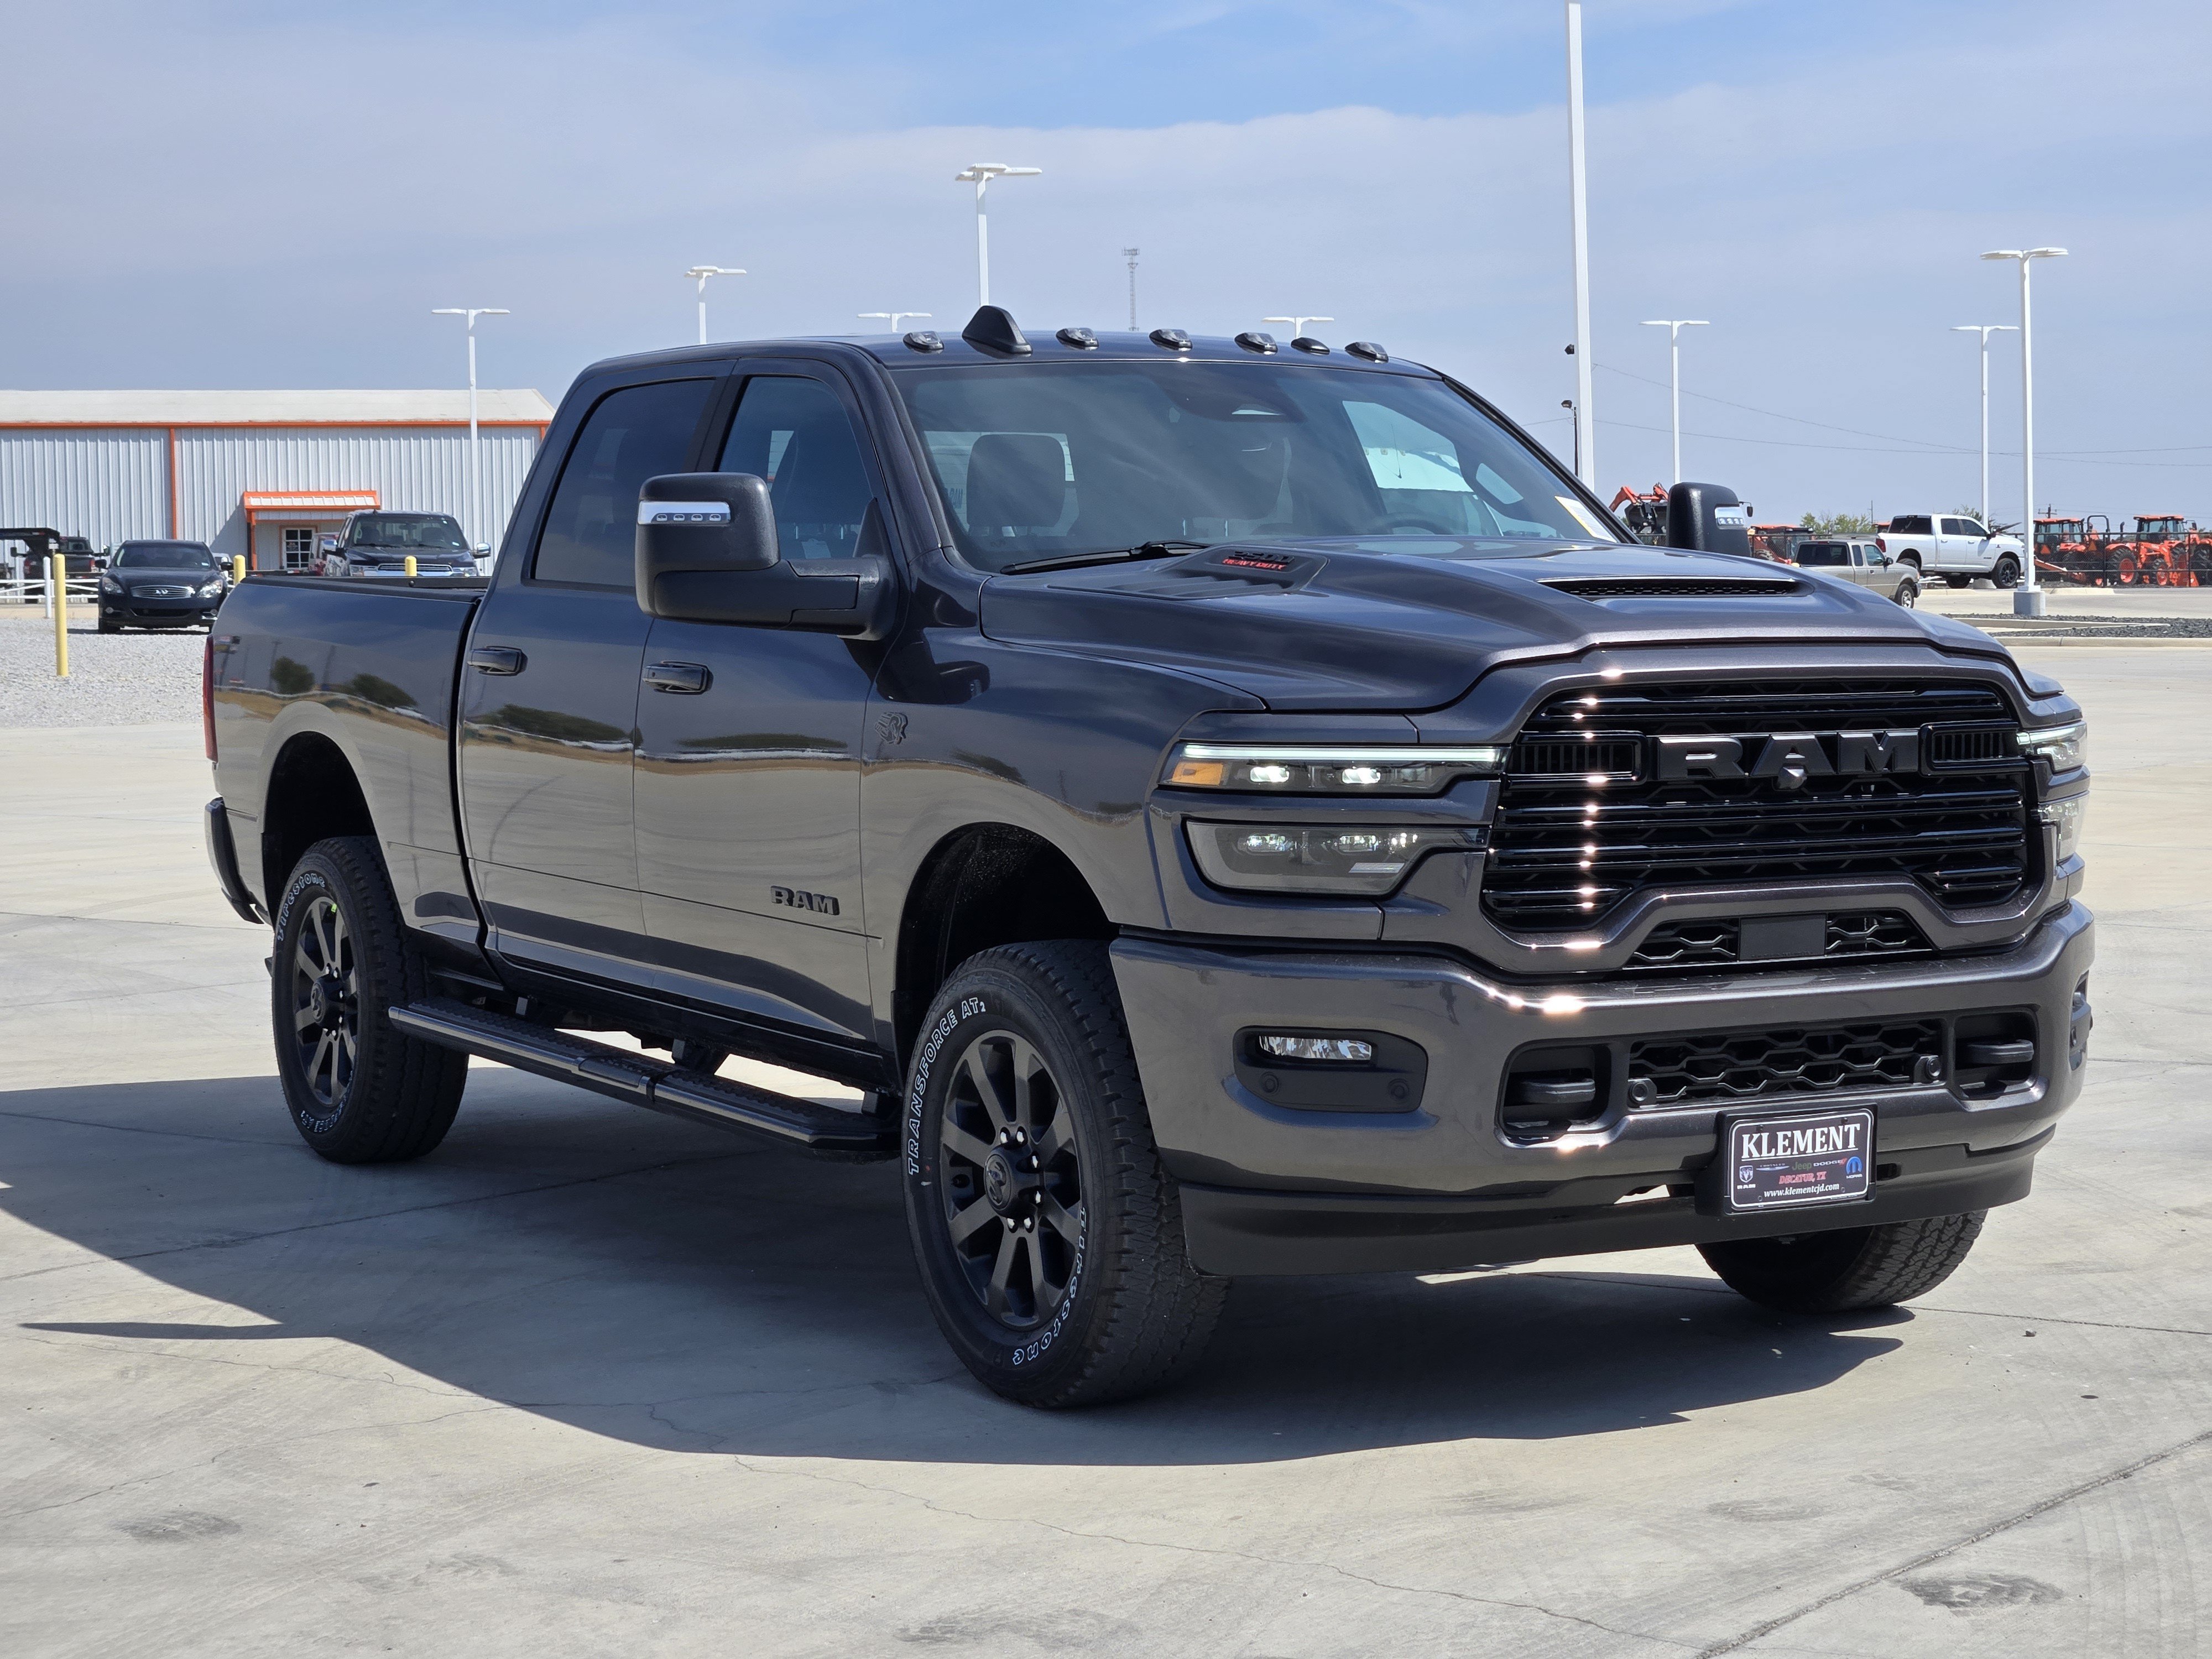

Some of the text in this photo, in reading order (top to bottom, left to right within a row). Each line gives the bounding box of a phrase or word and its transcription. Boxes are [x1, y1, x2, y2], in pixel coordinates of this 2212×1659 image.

[1255, 562, 1287, 570] DUTY
[1659, 732, 1919, 780] RAM
[770, 885, 840, 916] RAM
[907, 1009, 958, 1176] TRANSFORCE
[1741, 1123, 1860, 1159] KLEMENT
[1778, 1171, 1827, 1184] DECATUR, TX
[1792, 1161, 1812, 1171] Jeep
[1764, 1183, 1840, 1198] www.klementcjd.com
